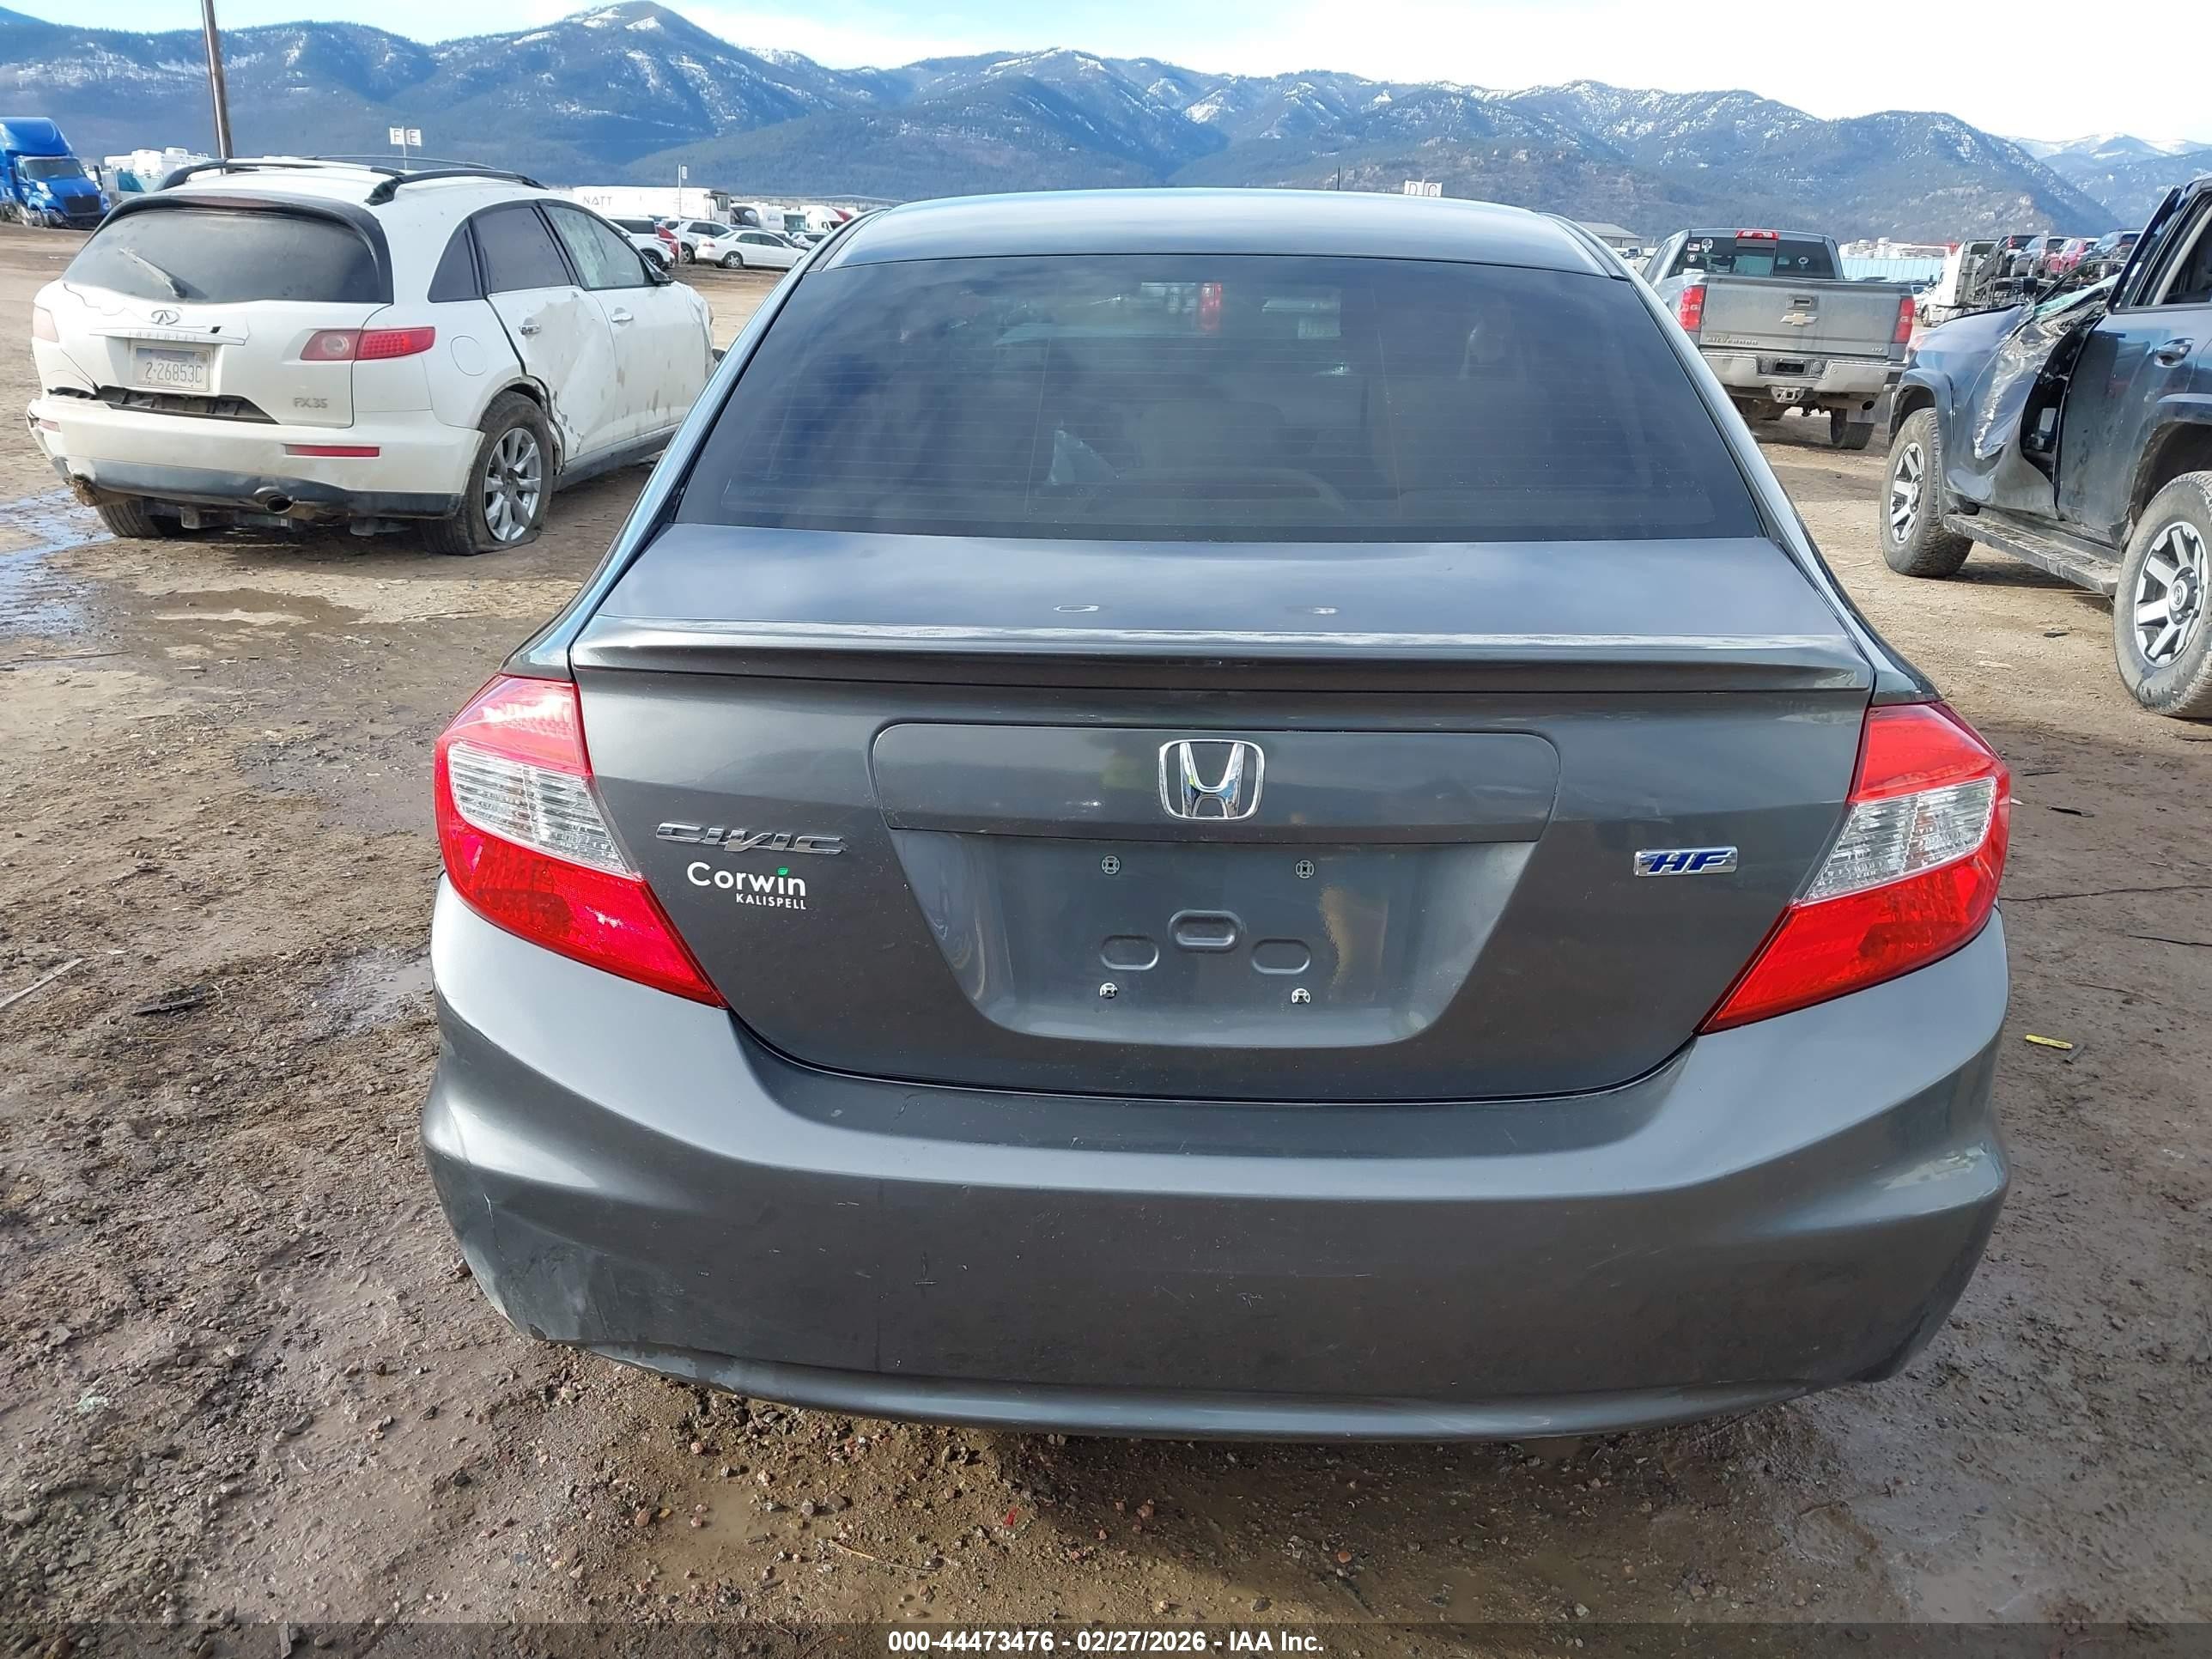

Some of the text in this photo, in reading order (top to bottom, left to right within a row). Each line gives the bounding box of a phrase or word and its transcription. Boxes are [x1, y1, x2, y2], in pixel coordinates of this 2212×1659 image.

[393, 130, 401, 143] F
[409, 131, 418, 143] E
[583, 195, 612, 206] NATT
[656, 822, 846, 854] CIVIC
[1647, 849, 1733, 874] HF
[687, 861, 806, 896] Corwin
[736, 893, 806, 910] KALISPELL
